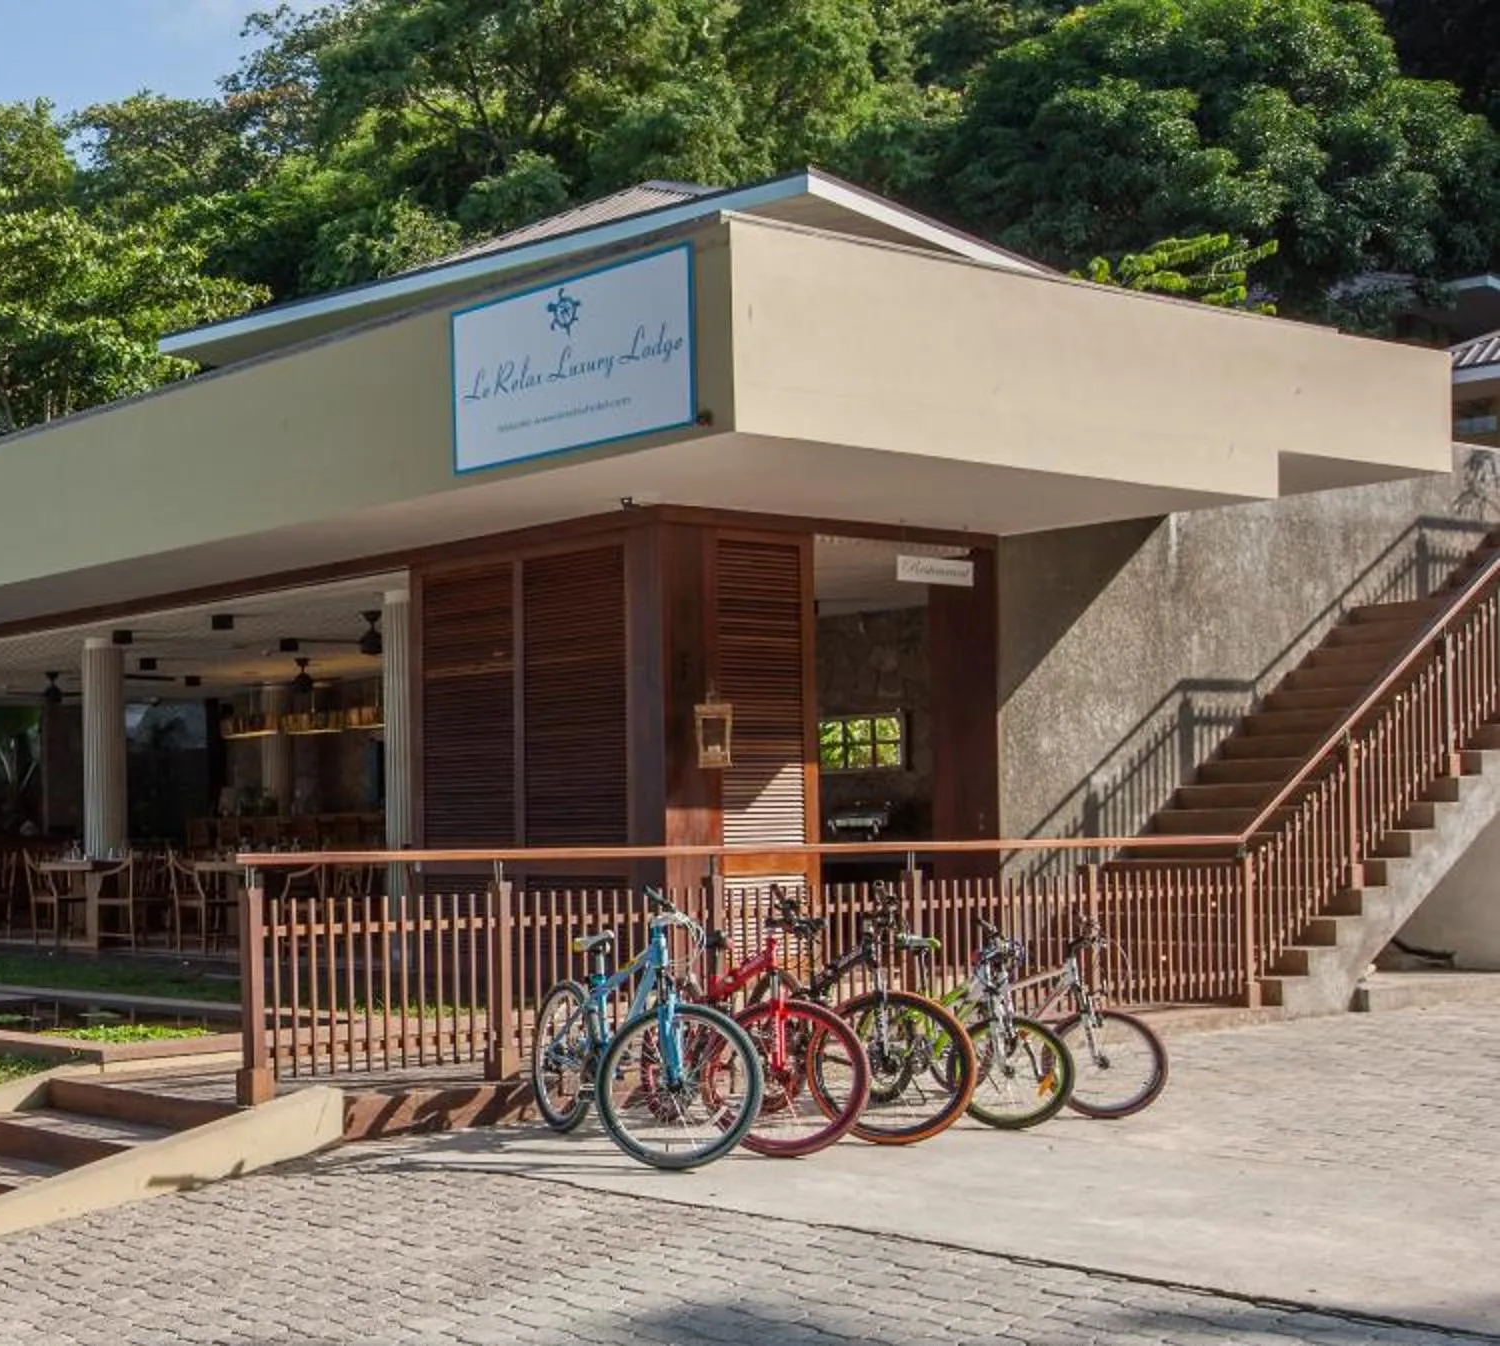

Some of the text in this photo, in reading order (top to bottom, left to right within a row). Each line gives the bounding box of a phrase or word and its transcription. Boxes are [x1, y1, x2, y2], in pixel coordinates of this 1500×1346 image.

[464, 320, 683, 400] Le Relax Luxury Lodge
